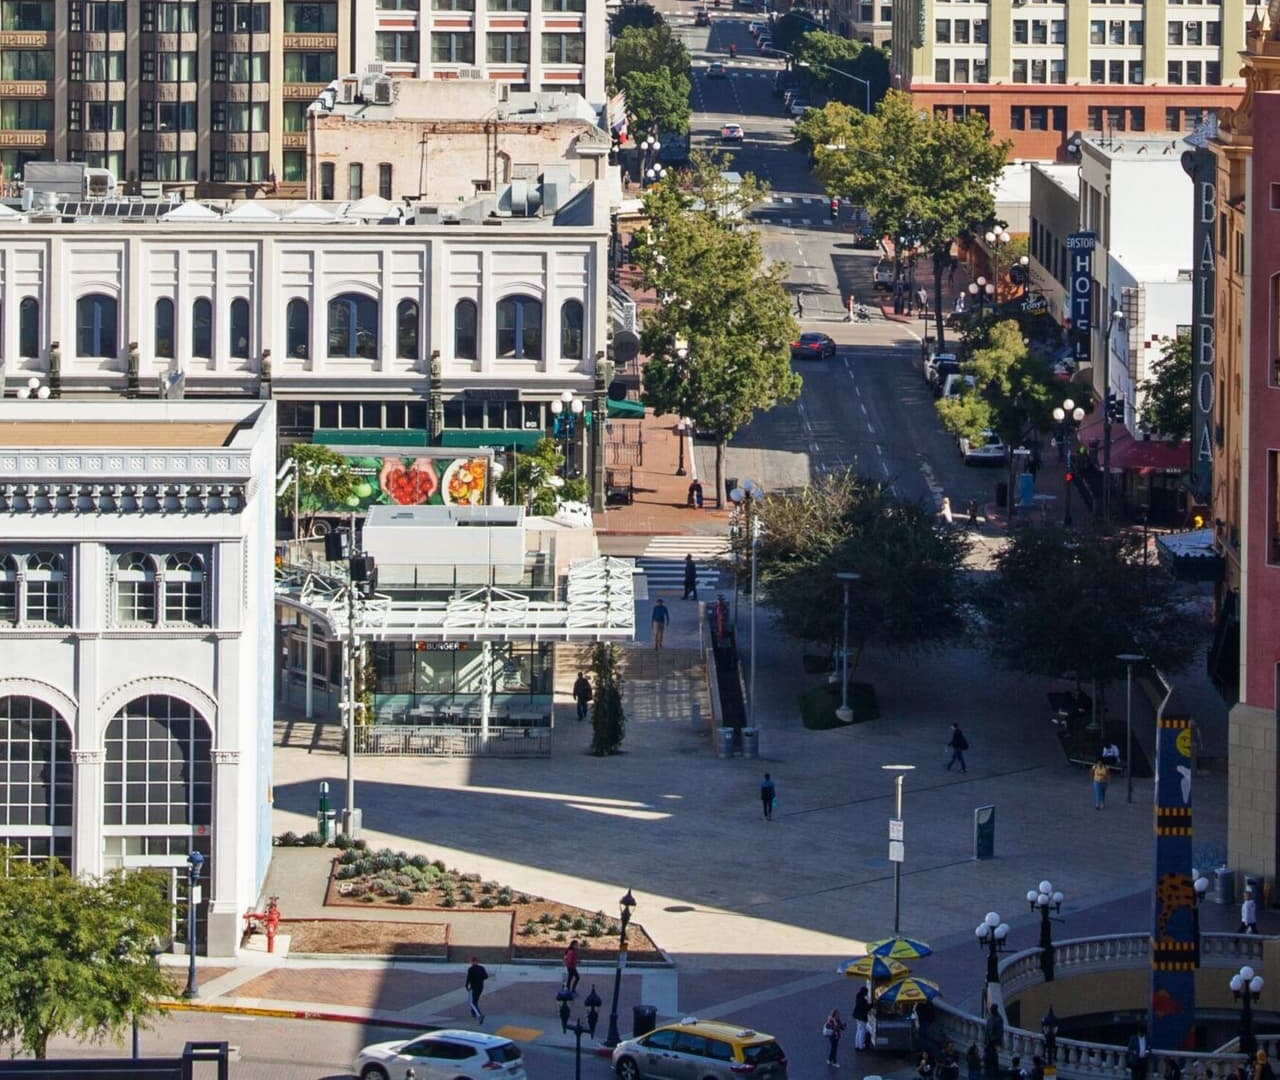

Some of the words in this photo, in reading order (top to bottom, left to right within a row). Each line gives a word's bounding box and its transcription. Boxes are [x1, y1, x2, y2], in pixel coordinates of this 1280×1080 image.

[1075, 255, 1090, 358] HOTEL
[1197, 181, 1217, 462] BALBOA
[427, 641, 460, 650] BURGER
